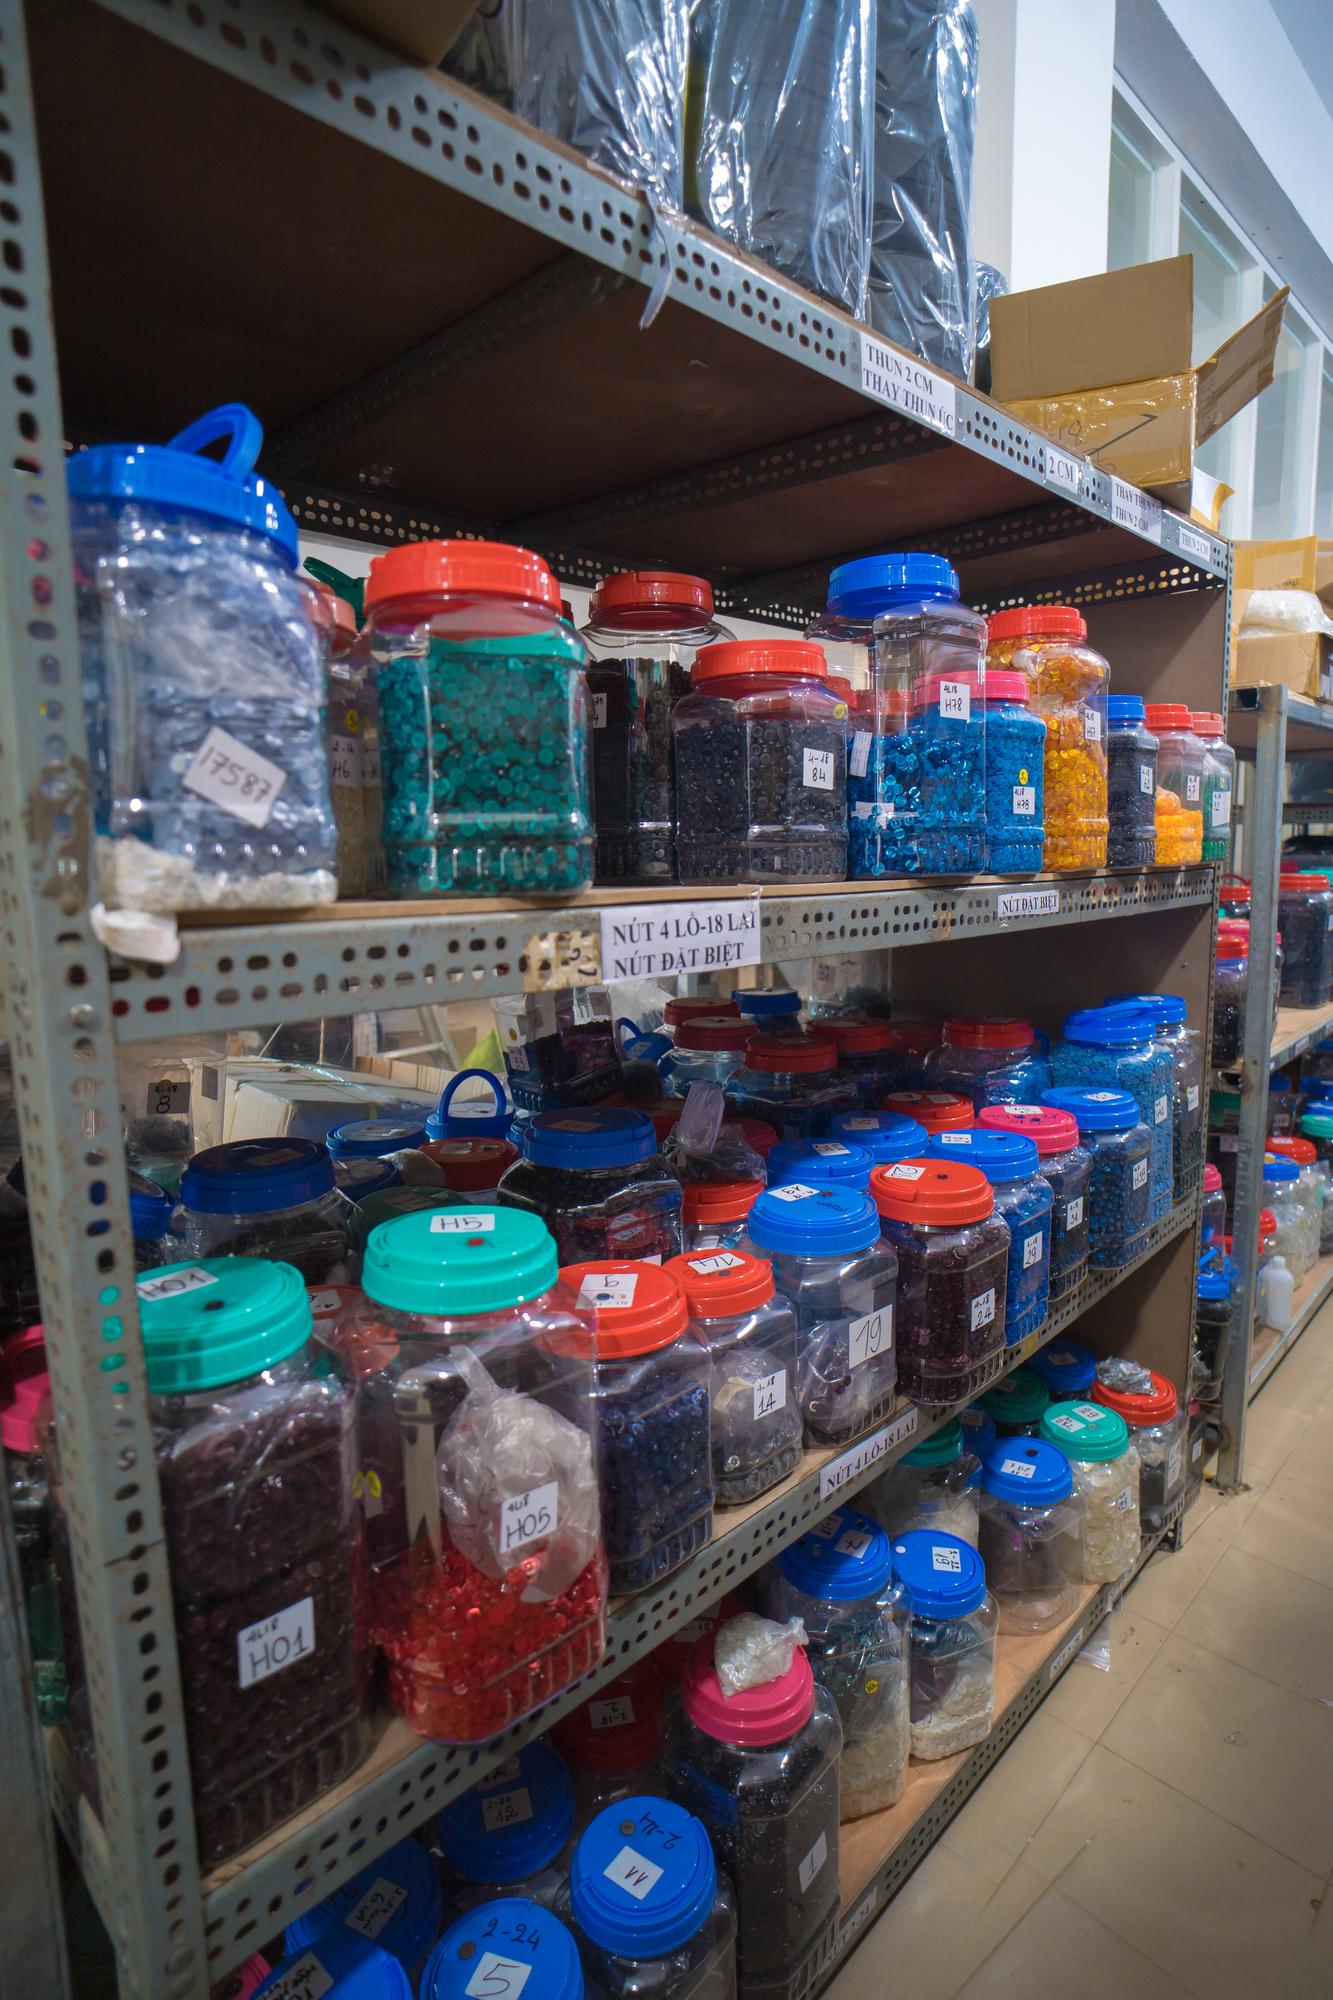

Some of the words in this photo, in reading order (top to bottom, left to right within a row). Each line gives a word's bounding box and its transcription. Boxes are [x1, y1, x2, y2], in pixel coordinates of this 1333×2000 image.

[866, 343, 902, 378] THUN
[904, 366, 912, 383] 2
[914, 372, 933, 395] CM
[863, 368, 900, 401] THAY
[903, 388, 936, 419] THUN
[938, 405, 954, 431] ÚC
[1049, 456, 1055, 475] 2
[1057, 460, 1074, 483] CM
[1115, 482, 1134, 504] THAY
[1115, 505, 1133, 524] THUN
[199, 745, 273, 804] 17587
[812, 767, 826, 782] 84
[1002, 895, 1020, 915] NÚT
[612, 916, 654, 946] NÚT
[660, 919, 669, 939] 4
[614, 950, 656, 979] NÚT
[661, 947, 700, 975] ĐẶT
[704, 941, 744, 966] BIỆT
[156, 1095, 172, 1113] 8
[438, 1214, 483, 1231] H5
[975, 1307, 992, 1328] 24
[855, 1314, 882, 1358] 19
[757, 1392, 776, 1417] 14
[827, 1464, 852, 1492] NÚT
[855, 1456, 861, 1470] 4
[505, 1506, 551, 1549] H05
[249, 1625, 309, 1679] H01
[481, 1918, 540, 1951] 2-24
[475, 1962, 521, 1997] 5
